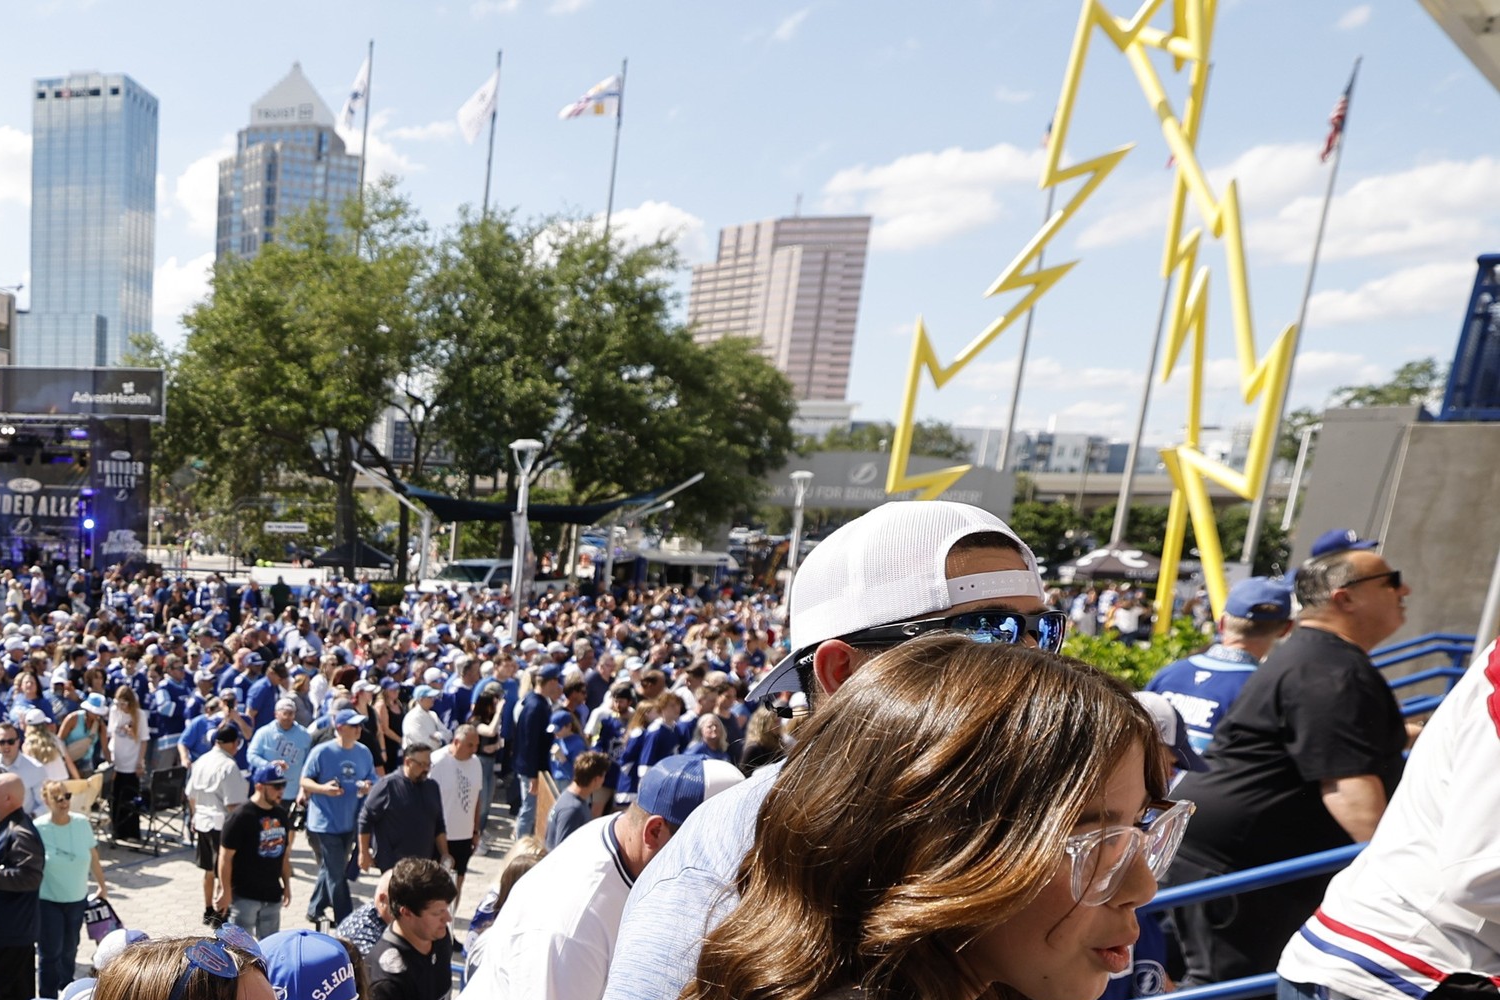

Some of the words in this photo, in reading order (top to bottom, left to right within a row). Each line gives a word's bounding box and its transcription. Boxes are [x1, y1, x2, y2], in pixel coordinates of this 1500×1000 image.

[72, 391, 152, 405] AdventHealth
[97, 460, 144, 475] THUNDER
[104, 474, 138, 489] ALLEY
[37, 497, 86, 517] ALLE
